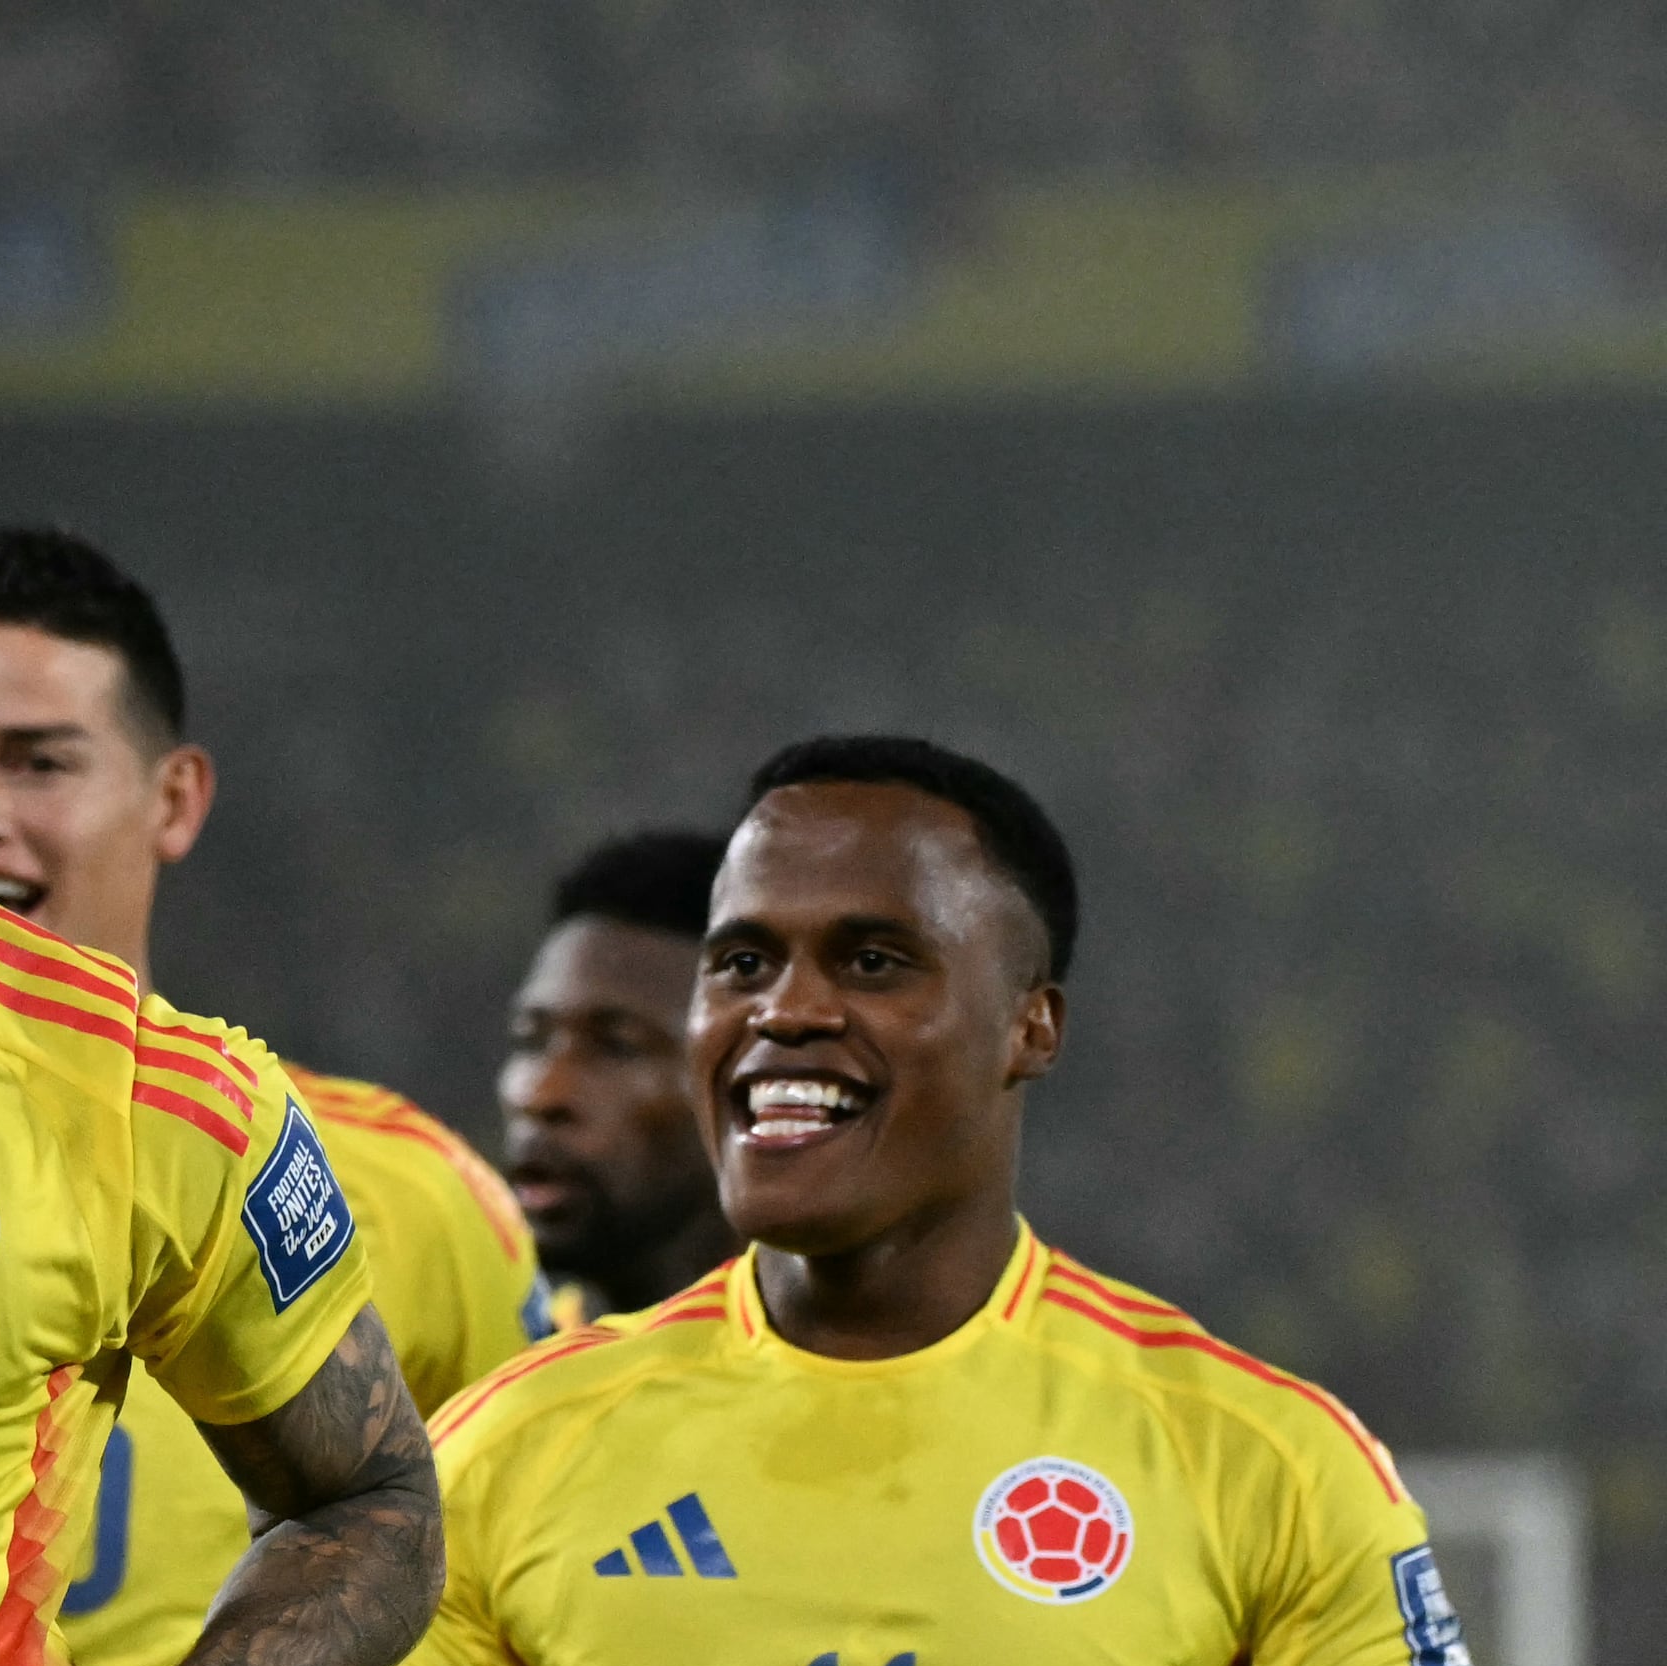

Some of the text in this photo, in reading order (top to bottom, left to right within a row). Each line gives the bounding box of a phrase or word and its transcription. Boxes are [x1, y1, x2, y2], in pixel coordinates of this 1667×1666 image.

[267, 1140, 309, 1213] FOOTBALL
[277, 1154, 321, 1232] UNITES
[280, 1171, 334, 1256] the World
[309, 1223, 332, 1252] FIFA
